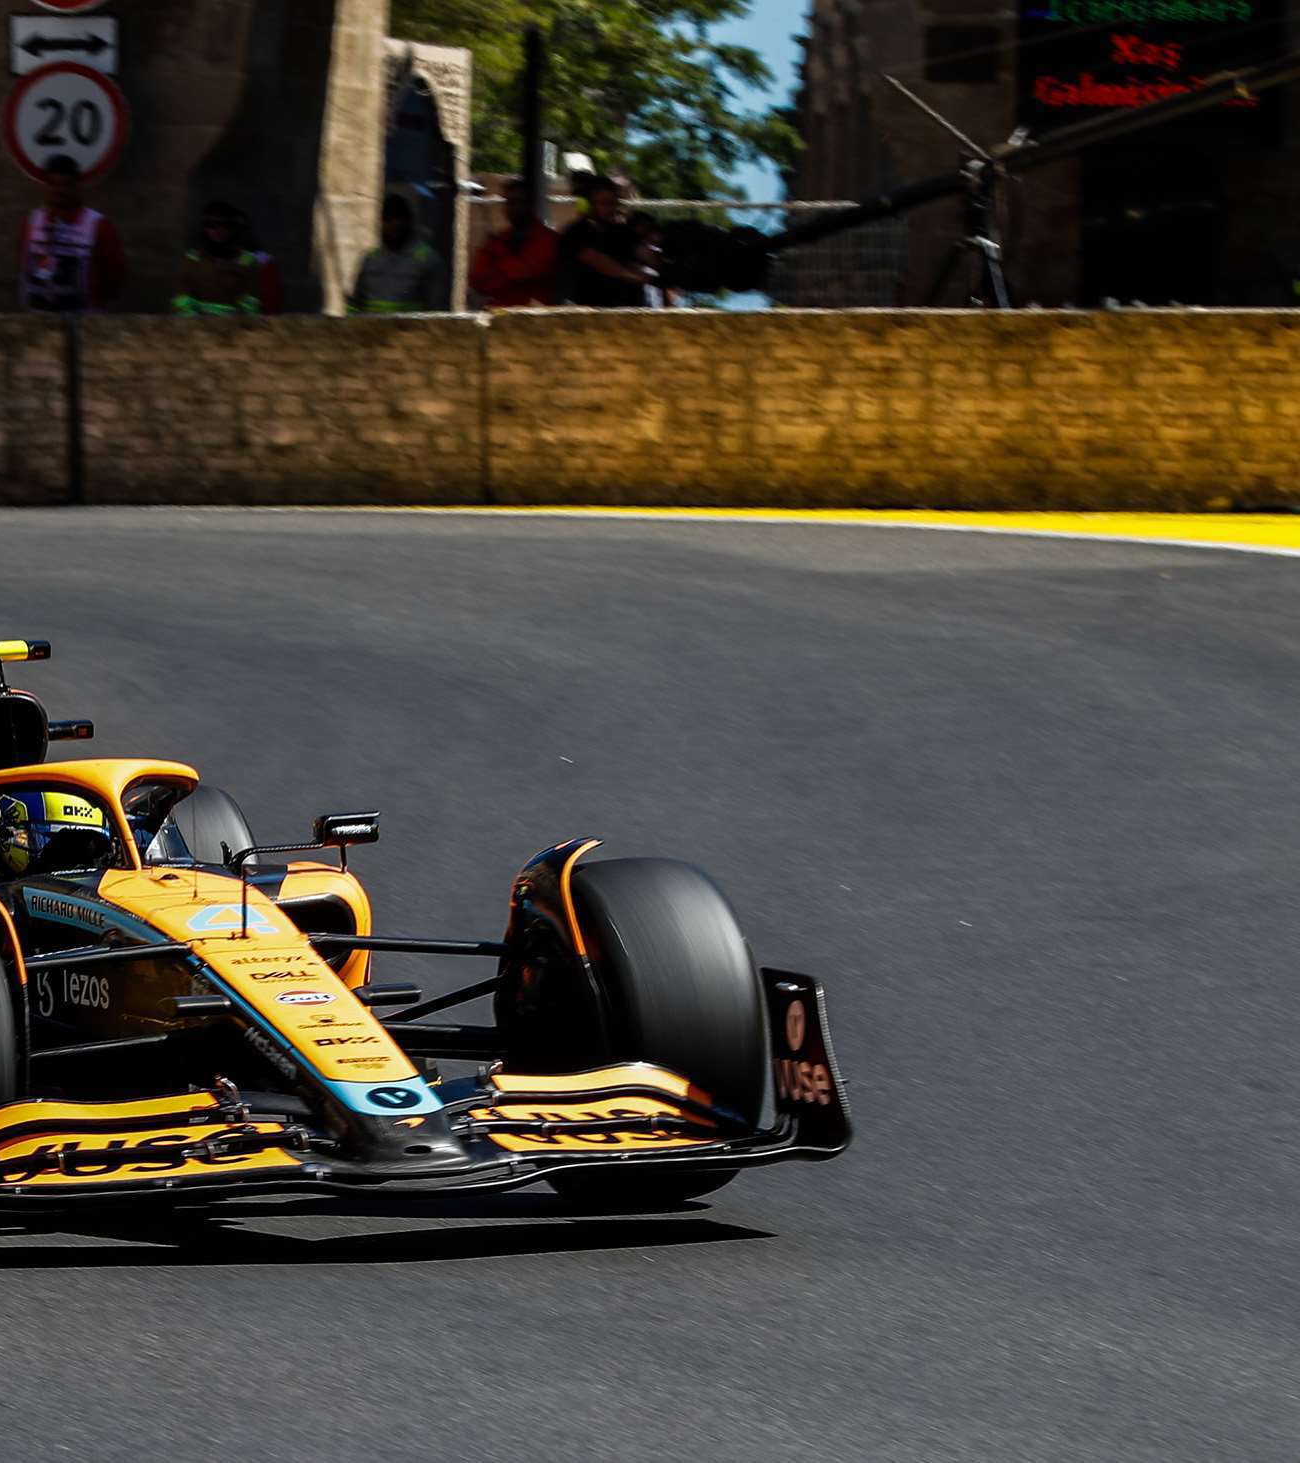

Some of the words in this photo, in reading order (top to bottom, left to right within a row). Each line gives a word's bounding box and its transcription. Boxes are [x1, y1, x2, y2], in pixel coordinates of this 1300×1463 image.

[34, 98, 102, 147] 20
[31, 895, 74, 919] RICHARD
[250, 970, 316, 980] DELL
